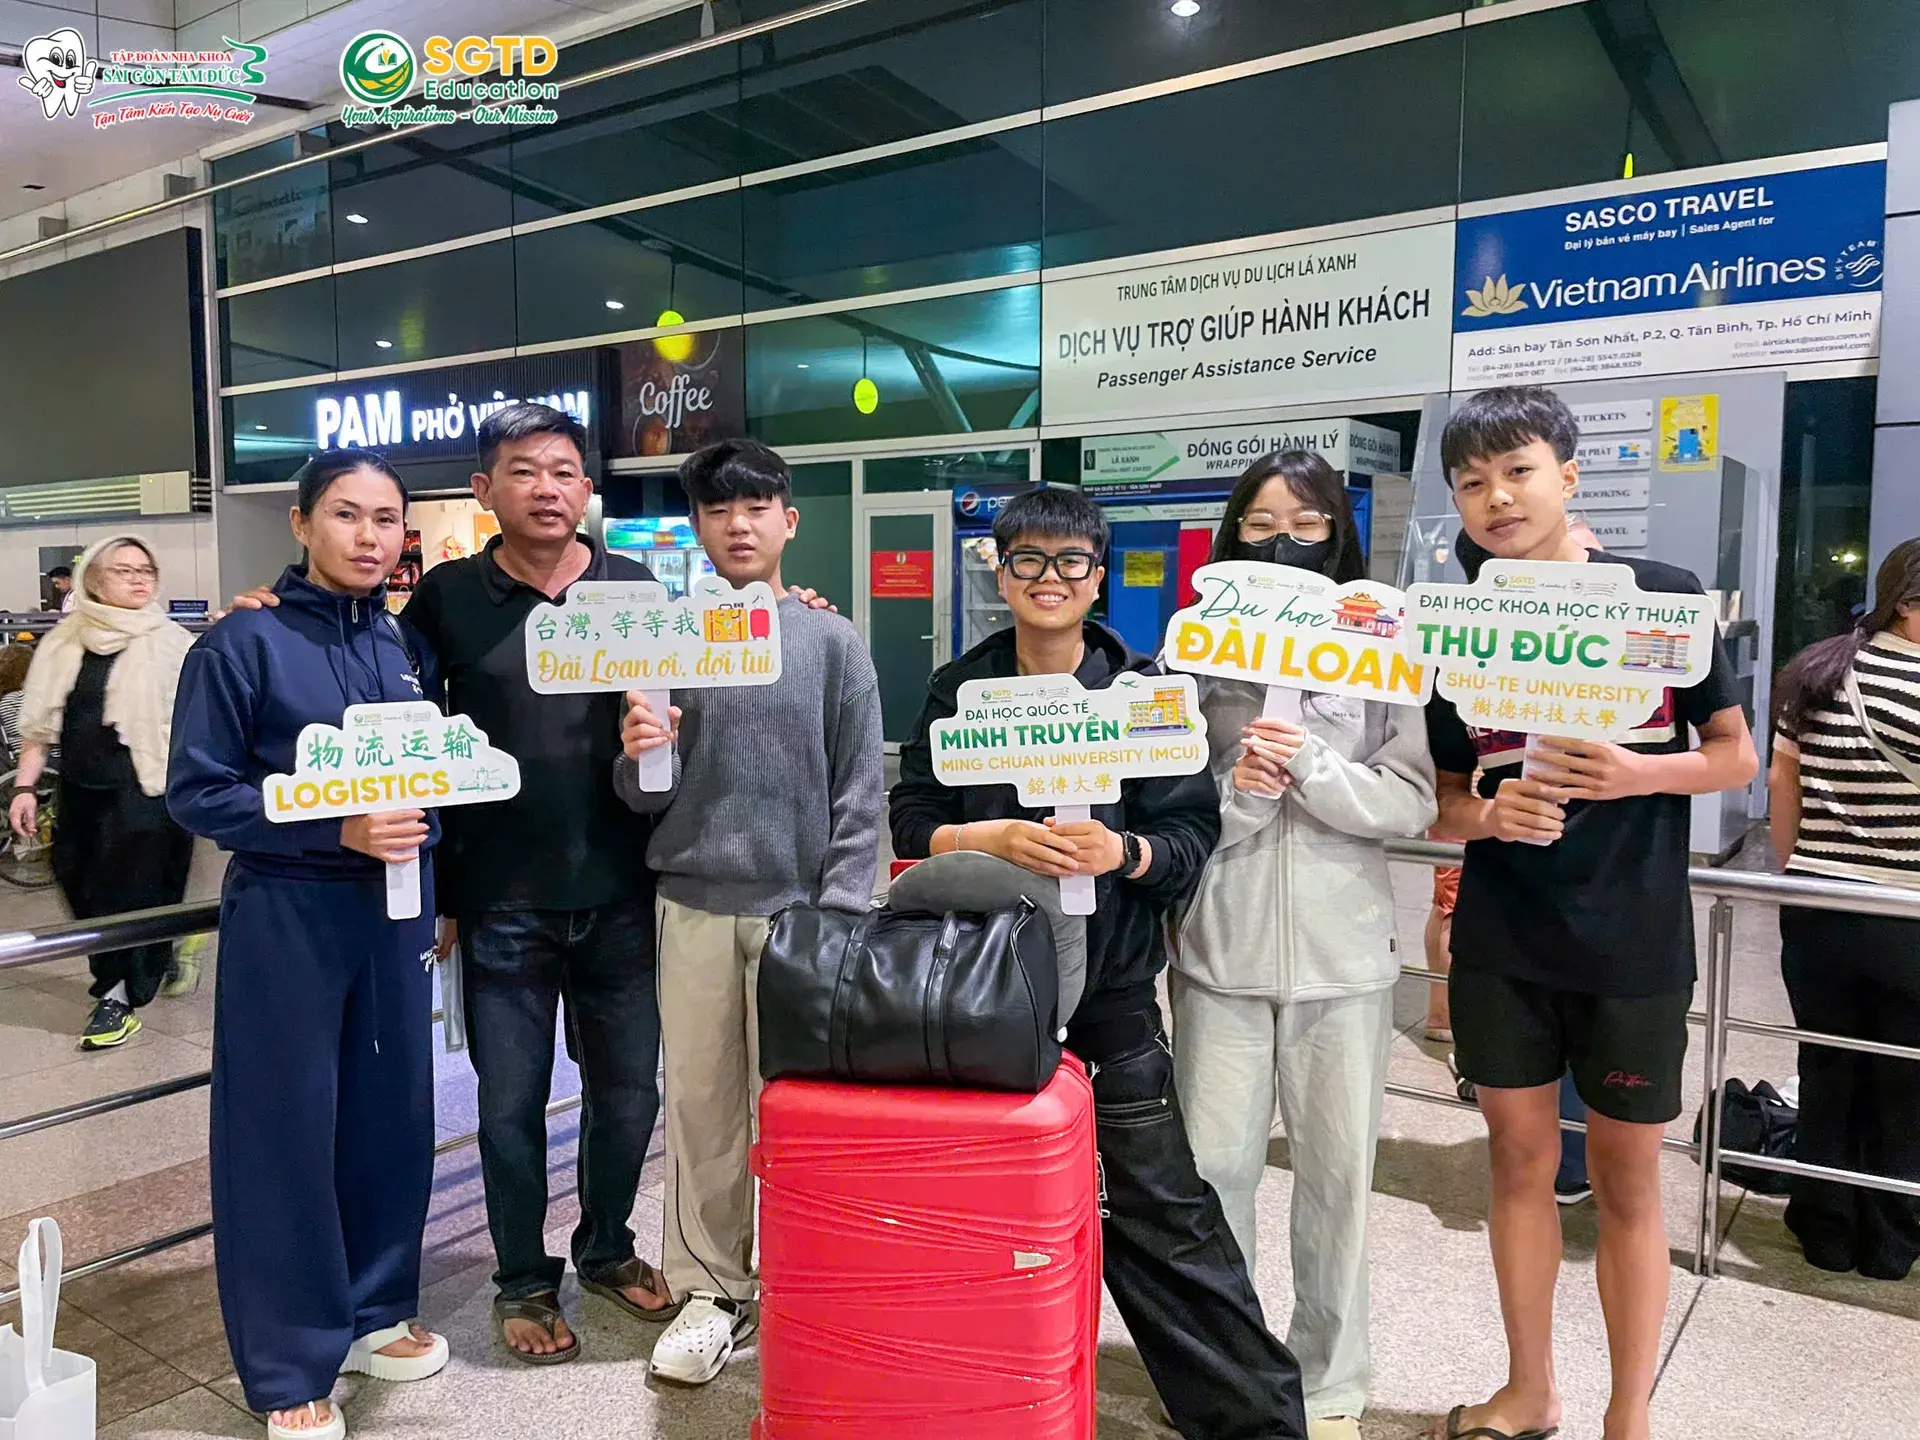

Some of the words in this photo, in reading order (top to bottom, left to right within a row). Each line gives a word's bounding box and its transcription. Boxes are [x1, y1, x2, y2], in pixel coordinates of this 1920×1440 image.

[1565, 200, 1658, 232] SASCO
[1664, 186, 1774, 218] TRAVEL
[1564, 240, 1583, 251] Đại
[1584, 237, 1594, 250] lý
[1596, 234, 1616, 246] bán
[1633, 230, 1656, 244] máy
[1658, 227, 1678, 242] bay
[1690, 222, 1719, 234] Sales
[1722, 218, 1754, 234] Agent
[1758, 216, 1774, 227] for
[1118, 283, 1158, 301] TRUNG
[1161, 276, 1187, 296] TÂM
[1190, 274, 1220, 294] DỊCH
[1222, 270, 1240, 287] VỤ
[1244, 266, 1262, 284] DU
[1266, 262, 1294, 284] LỊCH
[1298, 255, 1314, 277] LÁ
[1318, 253, 1357, 275] XANH
[1530, 271, 1676, 310] Vietnam
[1680, 255, 1826, 294] Airlines
[1059, 331, 1105, 364] DỊCH
[1113, 325, 1140, 358] VỤ
[1148, 316, 1194, 352] TRỢ
[1201, 305, 1254, 342] GIÚP
[1262, 299, 1329, 336] HÀNH
[1339, 286, 1430, 327] KHÁCH
[1468, 348, 1496, 358] Add:
[1524, 342, 1547, 353] bay
[1576, 338, 1600, 348] Sơn
[1670, 328, 1684, 338] Q.
[1756, 319, 1778, 332] Tp.
[1782, 316, 1802, 328] Hồ
[1806, 313, 1830, 325] Chí
[1835, 310, 1872, 322] Minh
[1098, 364, 1188, 388] Passenger
[1192, 354, 1295, 380] Assistance
[1302, 347, 1377, 369] Service
[317, 391, 401, 449] PAM
[412, 393, 464, 441] PHỞ
[640, 375, 713, 428] Coffee
[1584, 412, 1626, 422] TICKETS
[1187, 438, 1232, 458] ĐÓNG
[1238, 434, 1265, 454] GÓI
[1271, 432, 1318, 452] HÀNH
[1322, 429, 1339, 448] LÝ
[1582, 489, 1630, 499] BOOKING
[1200, 577, 1268, 621] Du
[1275, 595, 1333, 628] học
[1420, 595, 1448, 614] ĐẠI
[1454, 596, 1494, 614] HỌC
[1500, 600, 1550, 616] KHOA
[1556, 603, 1598, 622] HỌC
[1605, 602, 1630, 619] KỸ
[1636, 606, 1700, 628] THUẬT
[537, 650, 586, 683] Đài
[590, 648, 653, 684] Loan
[696, 646, 735, 681] đợi
[741, 646, 776, 676] tui
[1176, 616, 1266, 672] ĐÀI
[1279, 636, 1424, 696] LOAN
[1417, 624, 1498, 668] THỤ
[1511, 624, 1611, 668] ĐỨC
[1446, 672, 1520, 692] SHU-TE
[1526, 681, 1652, 704] UNIVERSITY
[940, 726, 1008, 750] MINH
[1014, 713, 1120, 746] TRUYỀN
[965, 709, 988, 724] ĐẠI
[992, 706, 1023, 722] HỌC
[1026, 700, 1069, 718] QUỐC
[1073, 698, 1090, 714] TẾ
[307, 723, 480, 772] 物流运输
[941, 758, 984, 773] MING
[988, 754, 1045, 770] CHUAN
[1050, 750, 1144, 767] UNIVERSITY
[1149, 745, 1200, 763] (MCU)
[276, 770, 451, 812] LOGISTICS
[1026, 773, 1114, 796] 銘傳大學
